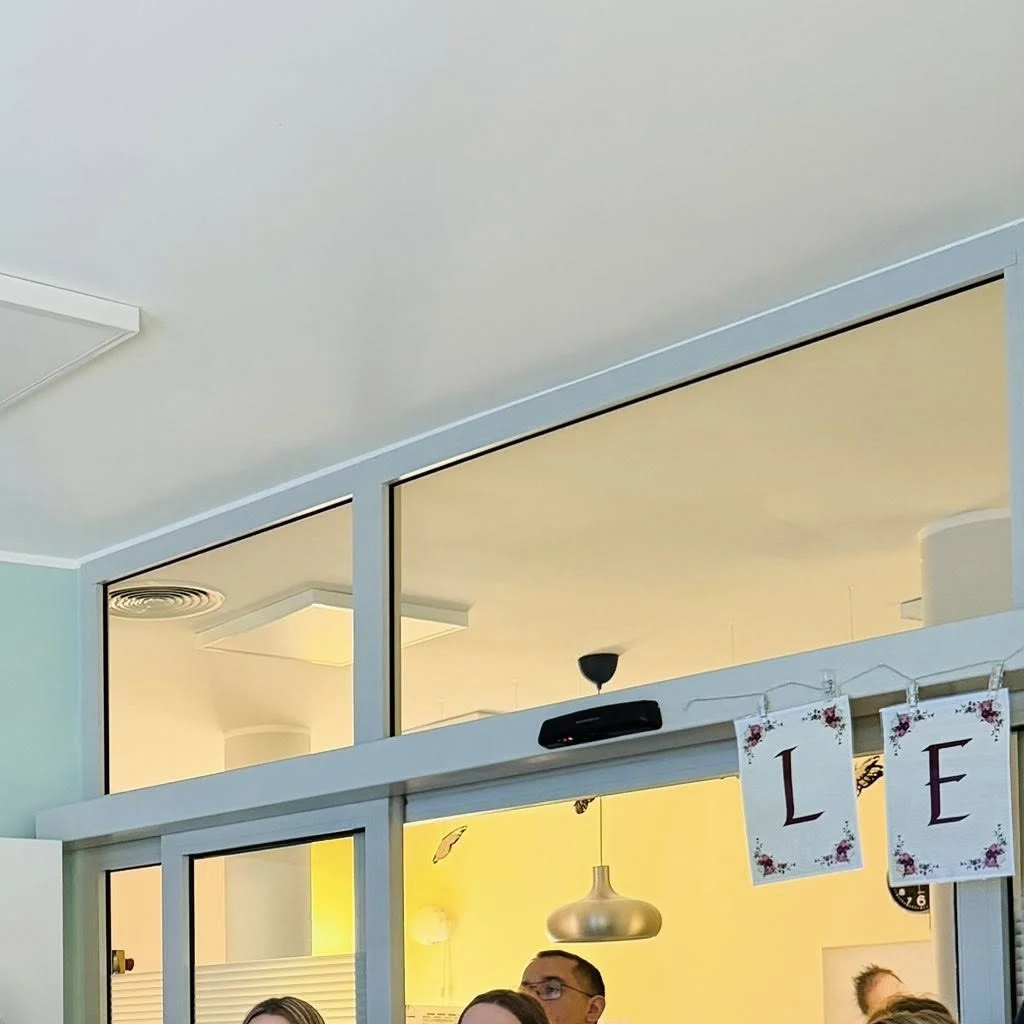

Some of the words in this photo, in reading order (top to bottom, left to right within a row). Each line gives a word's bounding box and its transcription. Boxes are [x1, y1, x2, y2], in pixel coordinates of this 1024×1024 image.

[774, 744, 826, 827] L
[921, 737, 974, 827] E
[916, 894, 927, 907] 6
